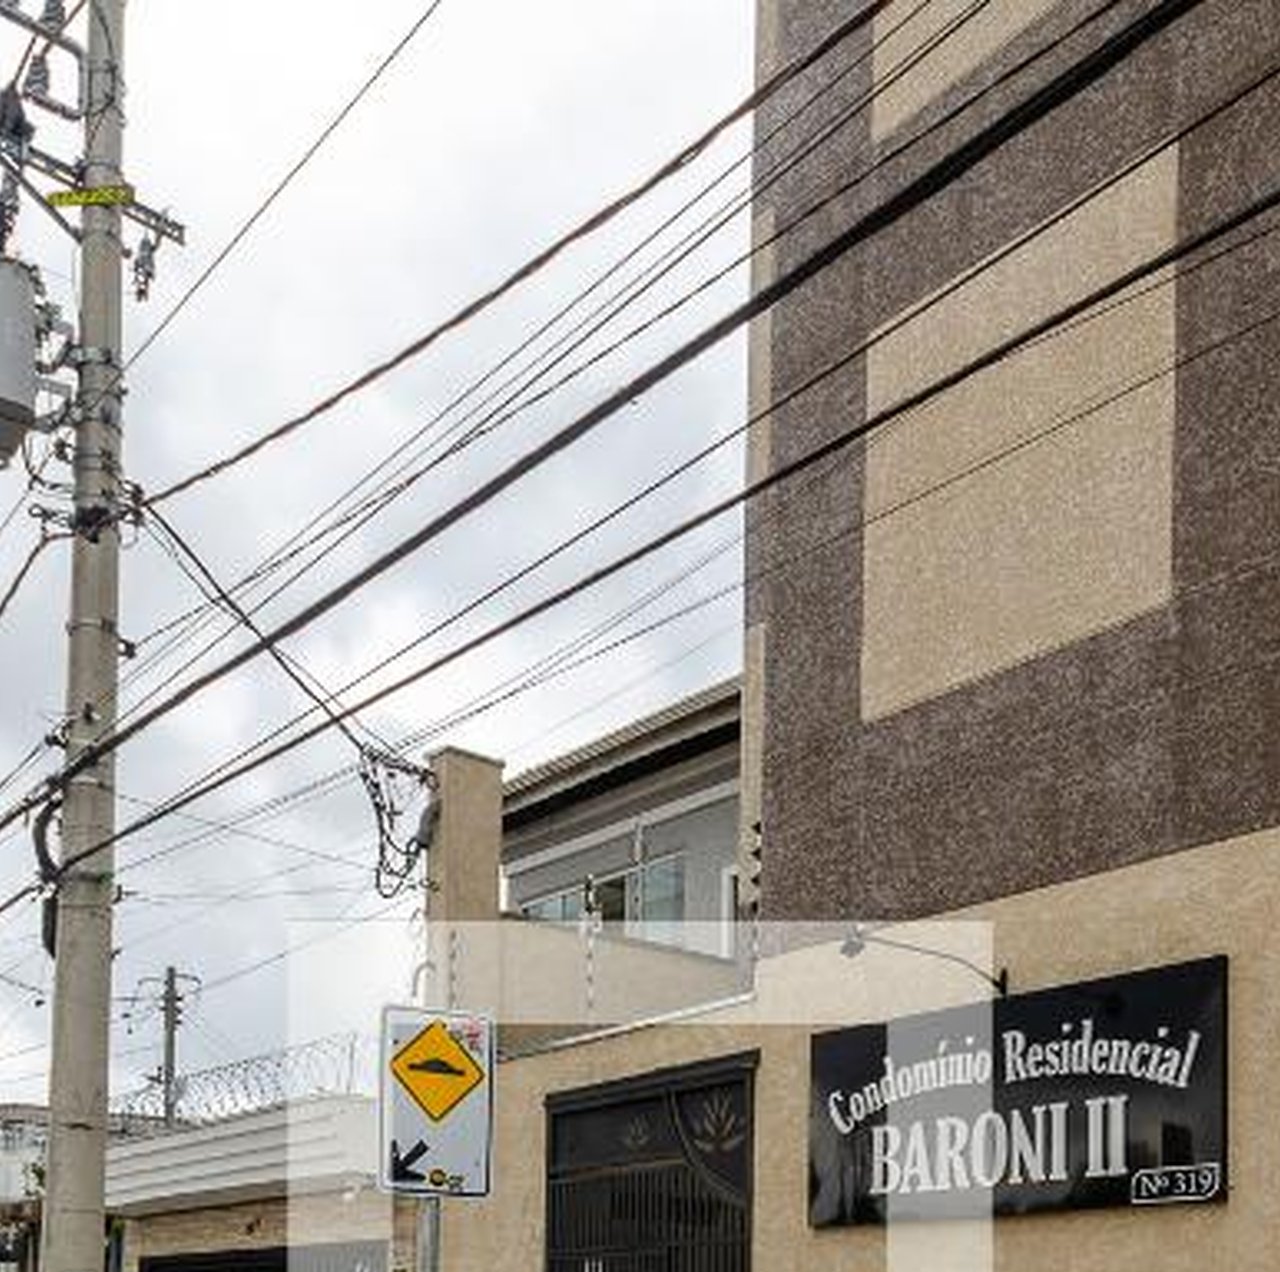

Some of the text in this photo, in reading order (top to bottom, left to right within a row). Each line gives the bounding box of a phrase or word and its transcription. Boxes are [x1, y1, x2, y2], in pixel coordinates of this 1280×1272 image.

[828, 1018, 1200, 1135] Condomínio Residencial
[868, 1094, 1129, 1195] BARONI II
[1173, 1169, 1213, 1194] 319
